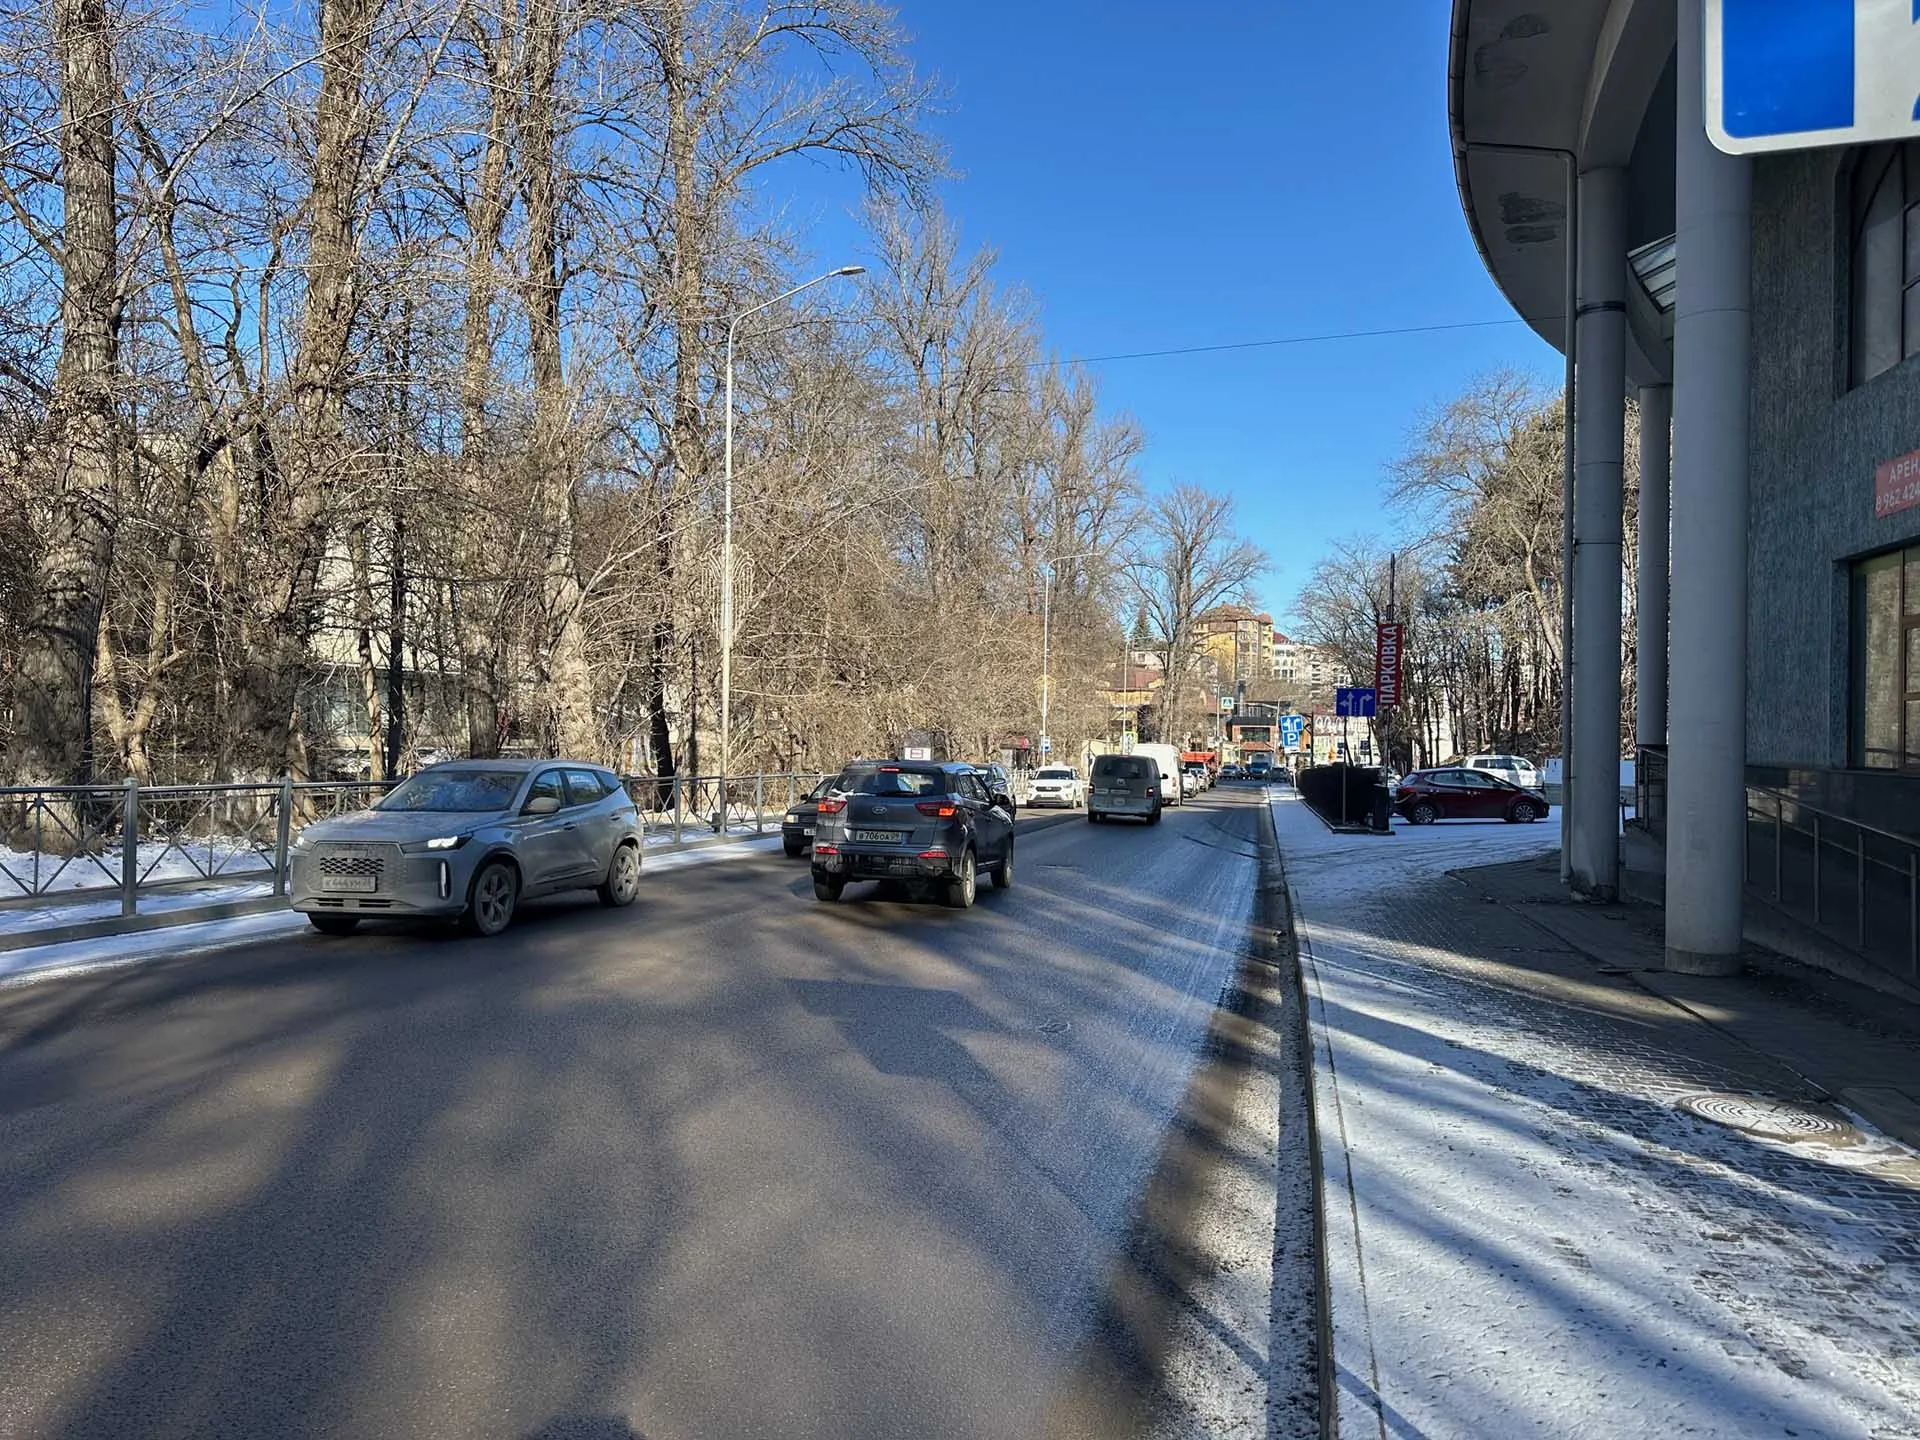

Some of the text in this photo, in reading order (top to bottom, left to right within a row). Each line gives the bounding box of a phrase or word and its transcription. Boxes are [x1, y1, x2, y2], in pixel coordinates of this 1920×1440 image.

[1889, 458, 1920, 483] АРЕН
[1379, 625, 1398, 704] ПАРКОВКА
[1287, 733, 1296, 743] P
